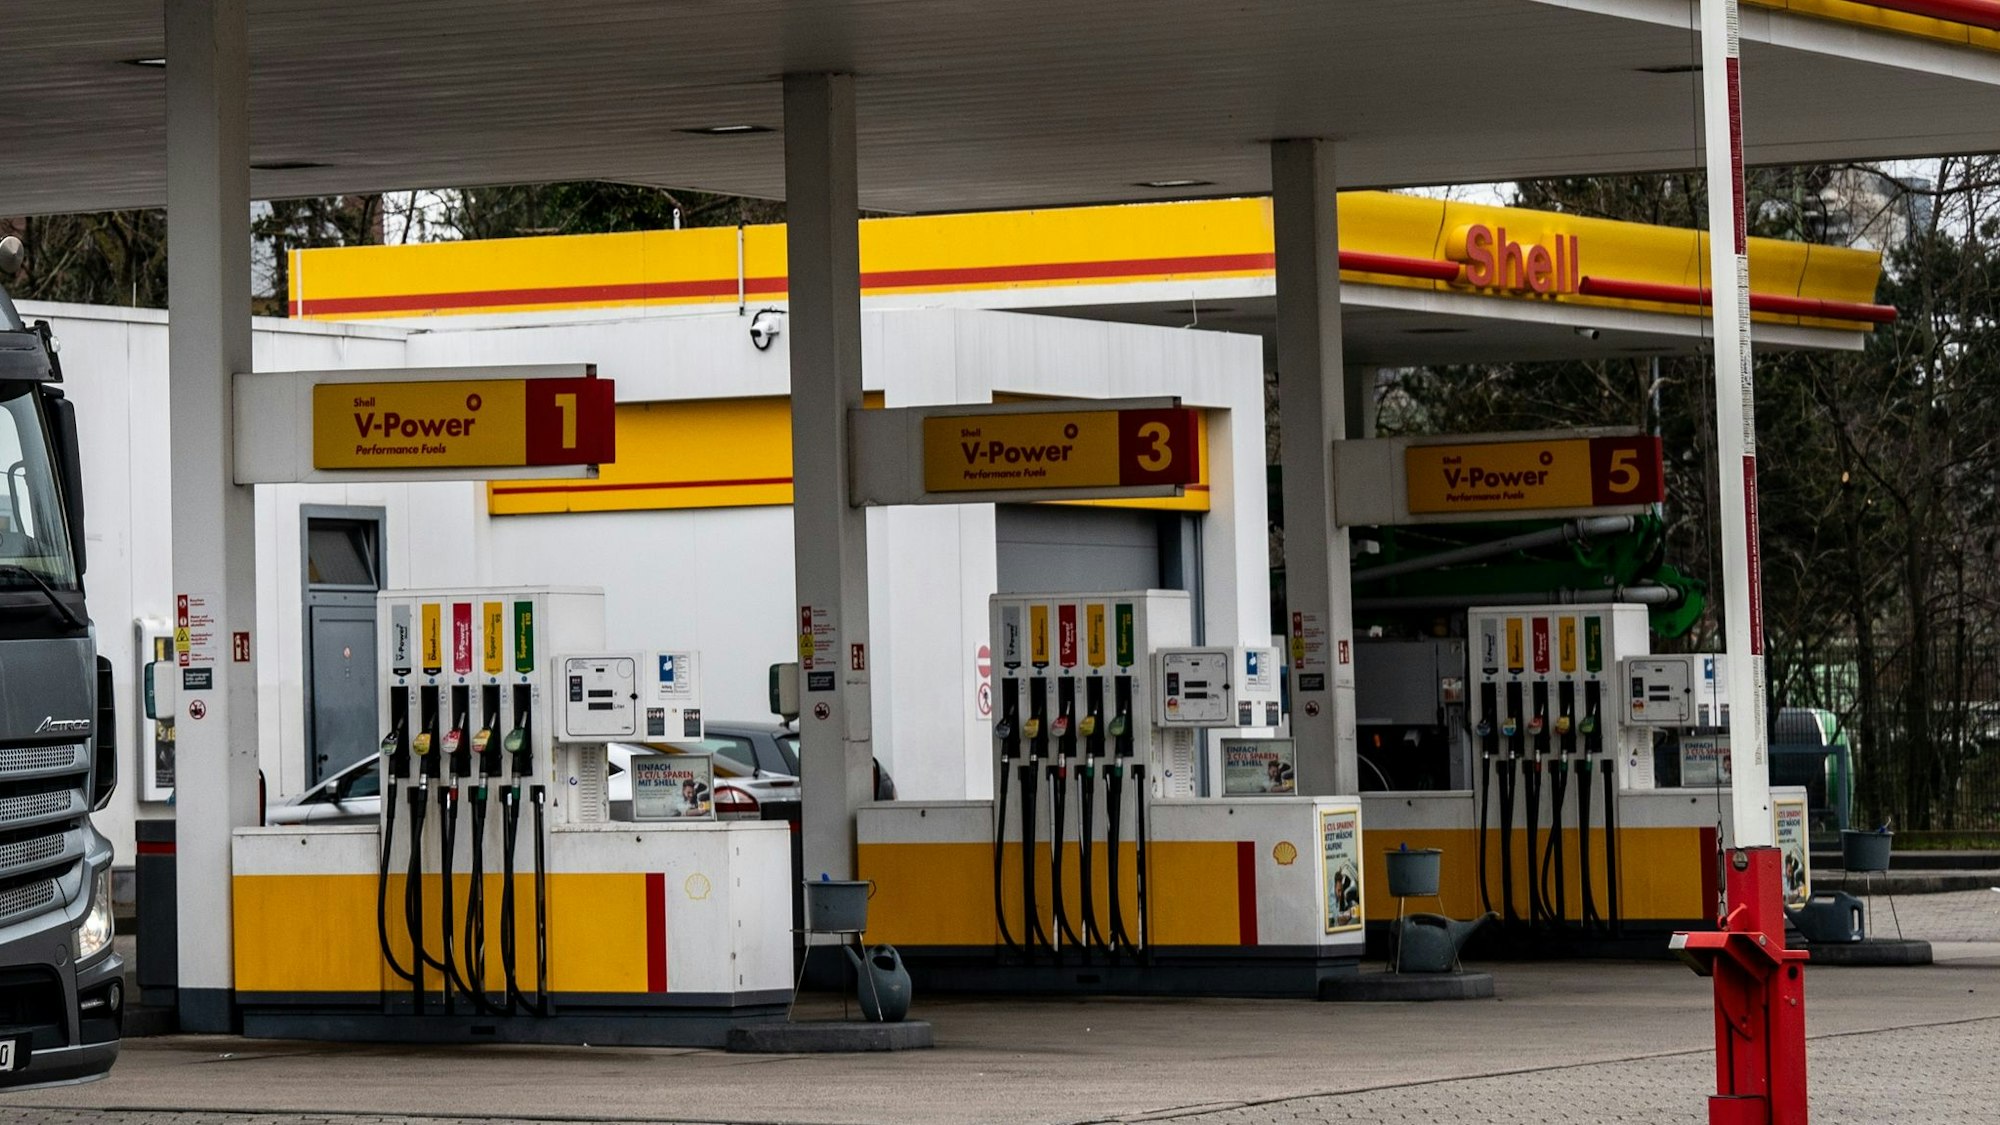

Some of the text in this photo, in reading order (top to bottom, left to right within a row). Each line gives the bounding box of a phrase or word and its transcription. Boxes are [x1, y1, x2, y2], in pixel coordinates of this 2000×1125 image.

[1466, 224, 1579, 294] Shell
[354, 397, 375, 407] Shell
[354, 412, 475, 438] V-Power
[555, 393, 577, 448] 1
[961, 428, 981, 438] Shell
[356, 443, 446, 455] Performance Fuels
[961, 441, 1073, 464] V-Power
[1137, 421, 1172, 472] 3
[1442, 455, 1462, 465] Shell
[963, 468, 1046, 480] Performance Fuels
[1443, 467, 1548, 489] V-Power
[1608, 449, 1640, 493] 5
[1446, 491, 1524, 502] Performance Fuels
[1249, 752, 1279, 760] SPAREN
